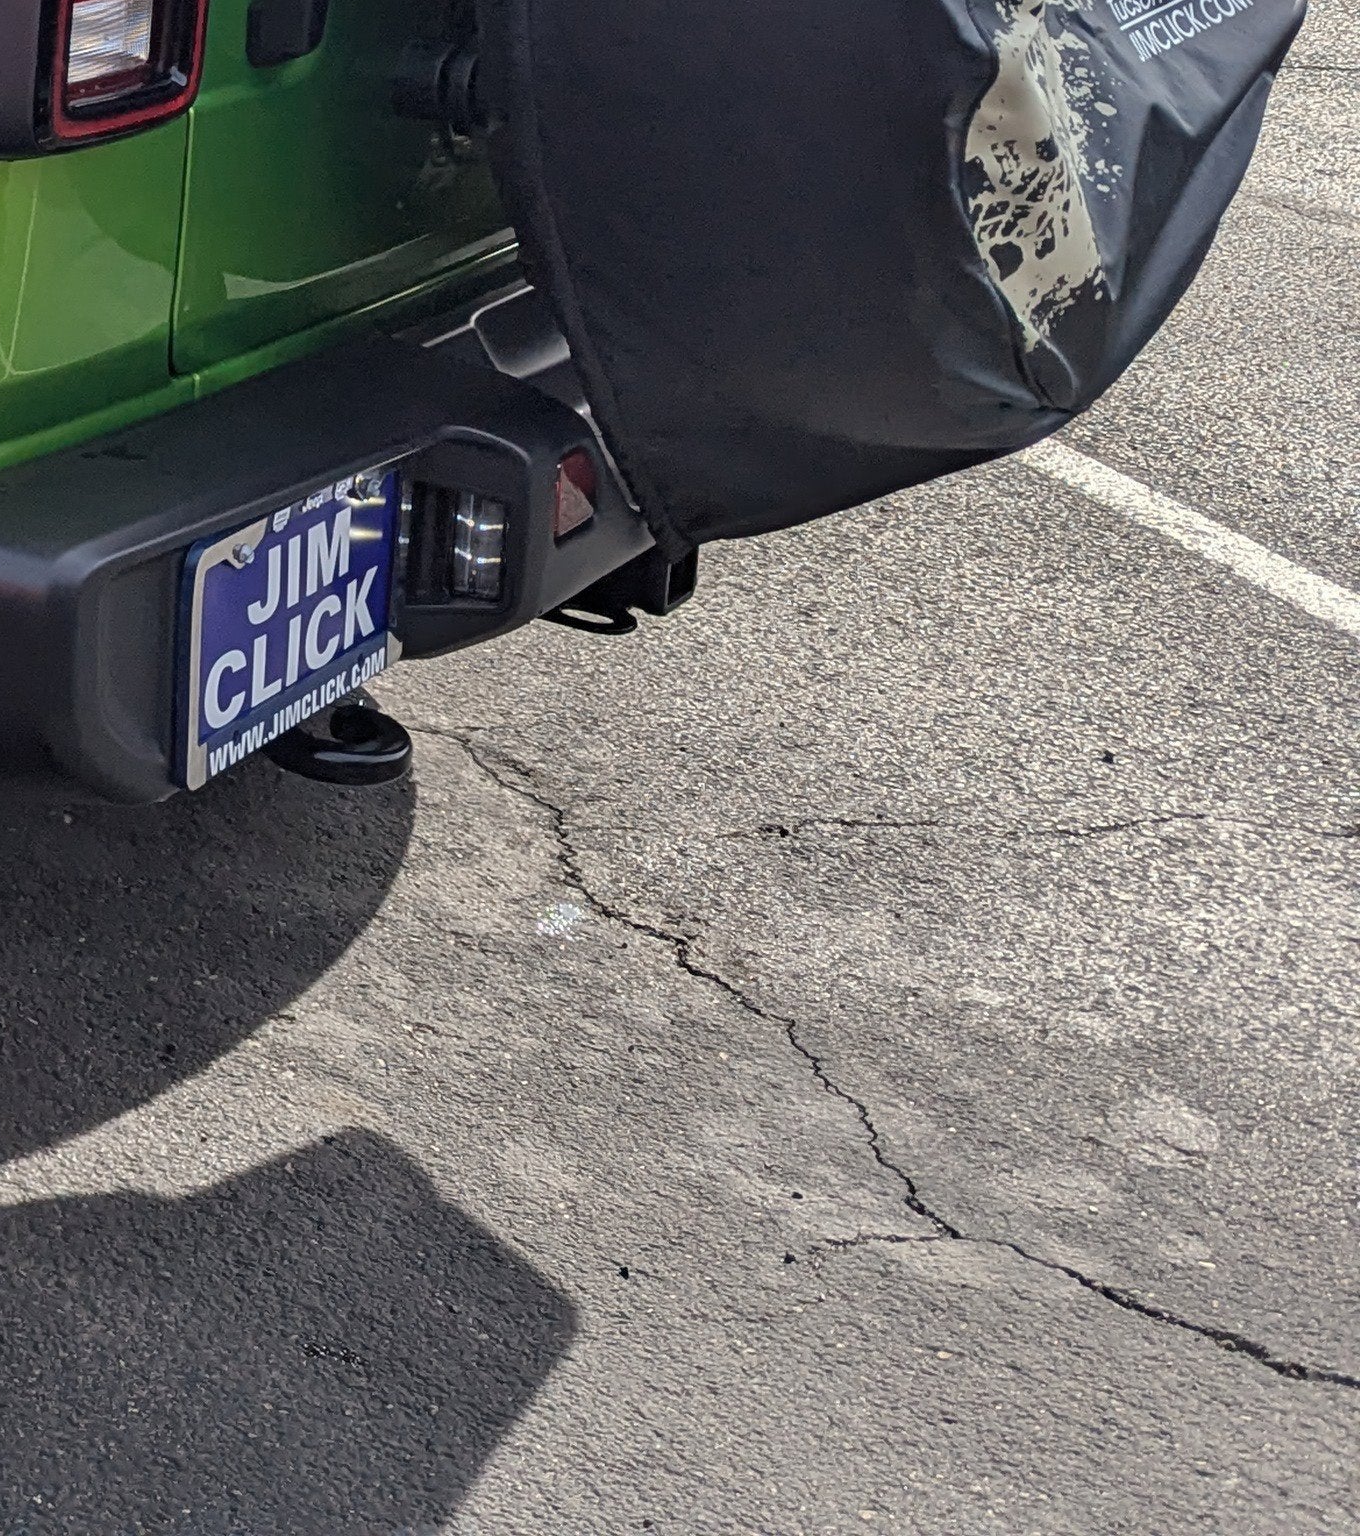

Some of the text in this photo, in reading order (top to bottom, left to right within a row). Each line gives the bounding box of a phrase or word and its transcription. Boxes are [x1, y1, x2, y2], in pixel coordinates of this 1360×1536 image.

[247, 506, 351, 625] JIM
[204, 565, 378, 729] CLICK
[209, 647, 386, 776] WWW.JIMCLICK.COM
